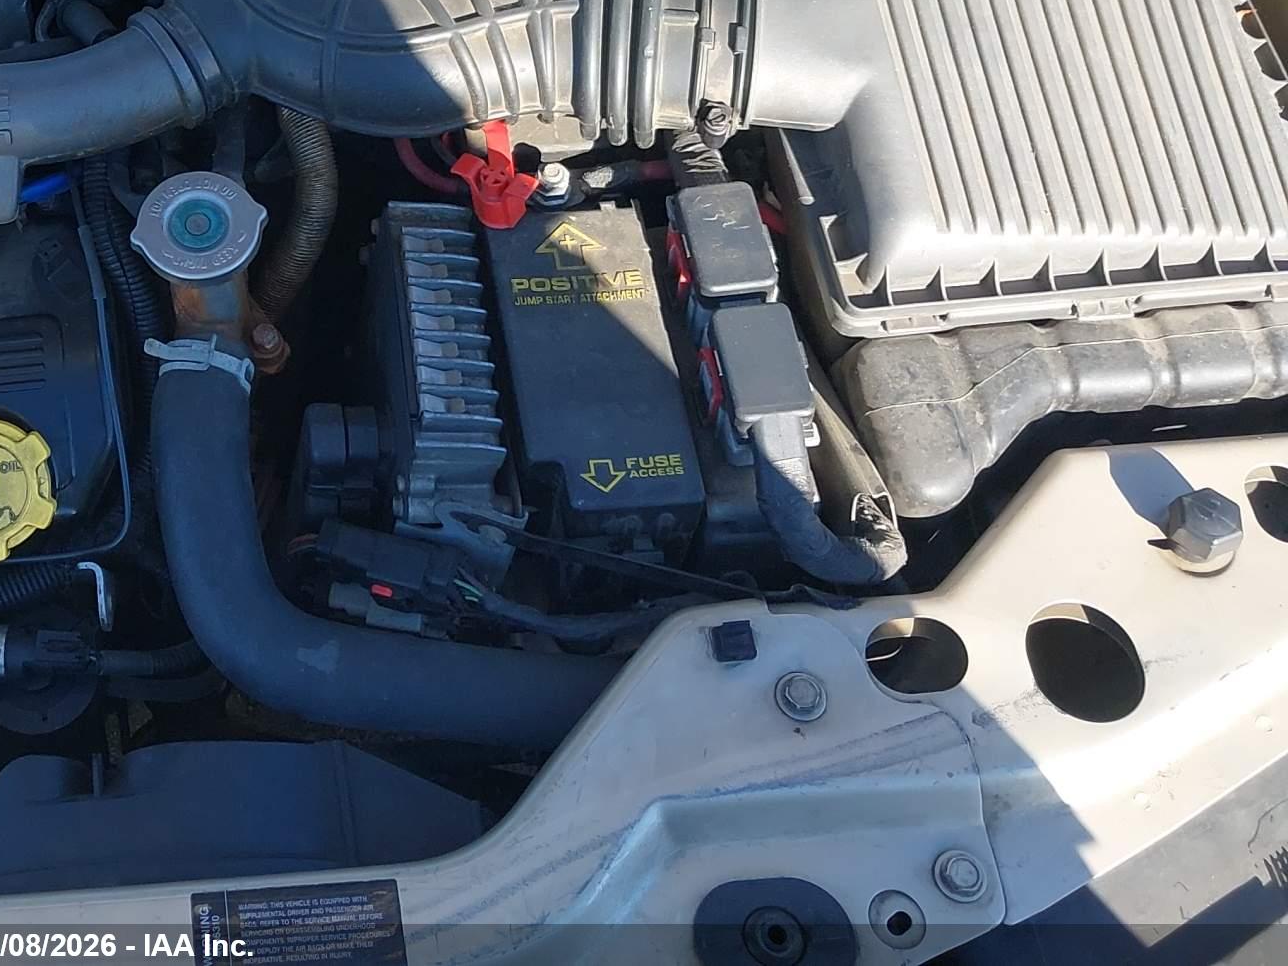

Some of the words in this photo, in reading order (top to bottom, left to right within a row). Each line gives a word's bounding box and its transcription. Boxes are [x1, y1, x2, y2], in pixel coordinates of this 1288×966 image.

[511, 269, 644, 293] POSITIVE
[515, 296, 543, 306] JUMP
[546, 295, 575, 305] START
[580, 289, 645, 304] ATTACHMENT
[0, 460, 24, 474] OIL
[626, 454, 682, 469] FUSE
[629, 467, 684, 478] ACCESS
